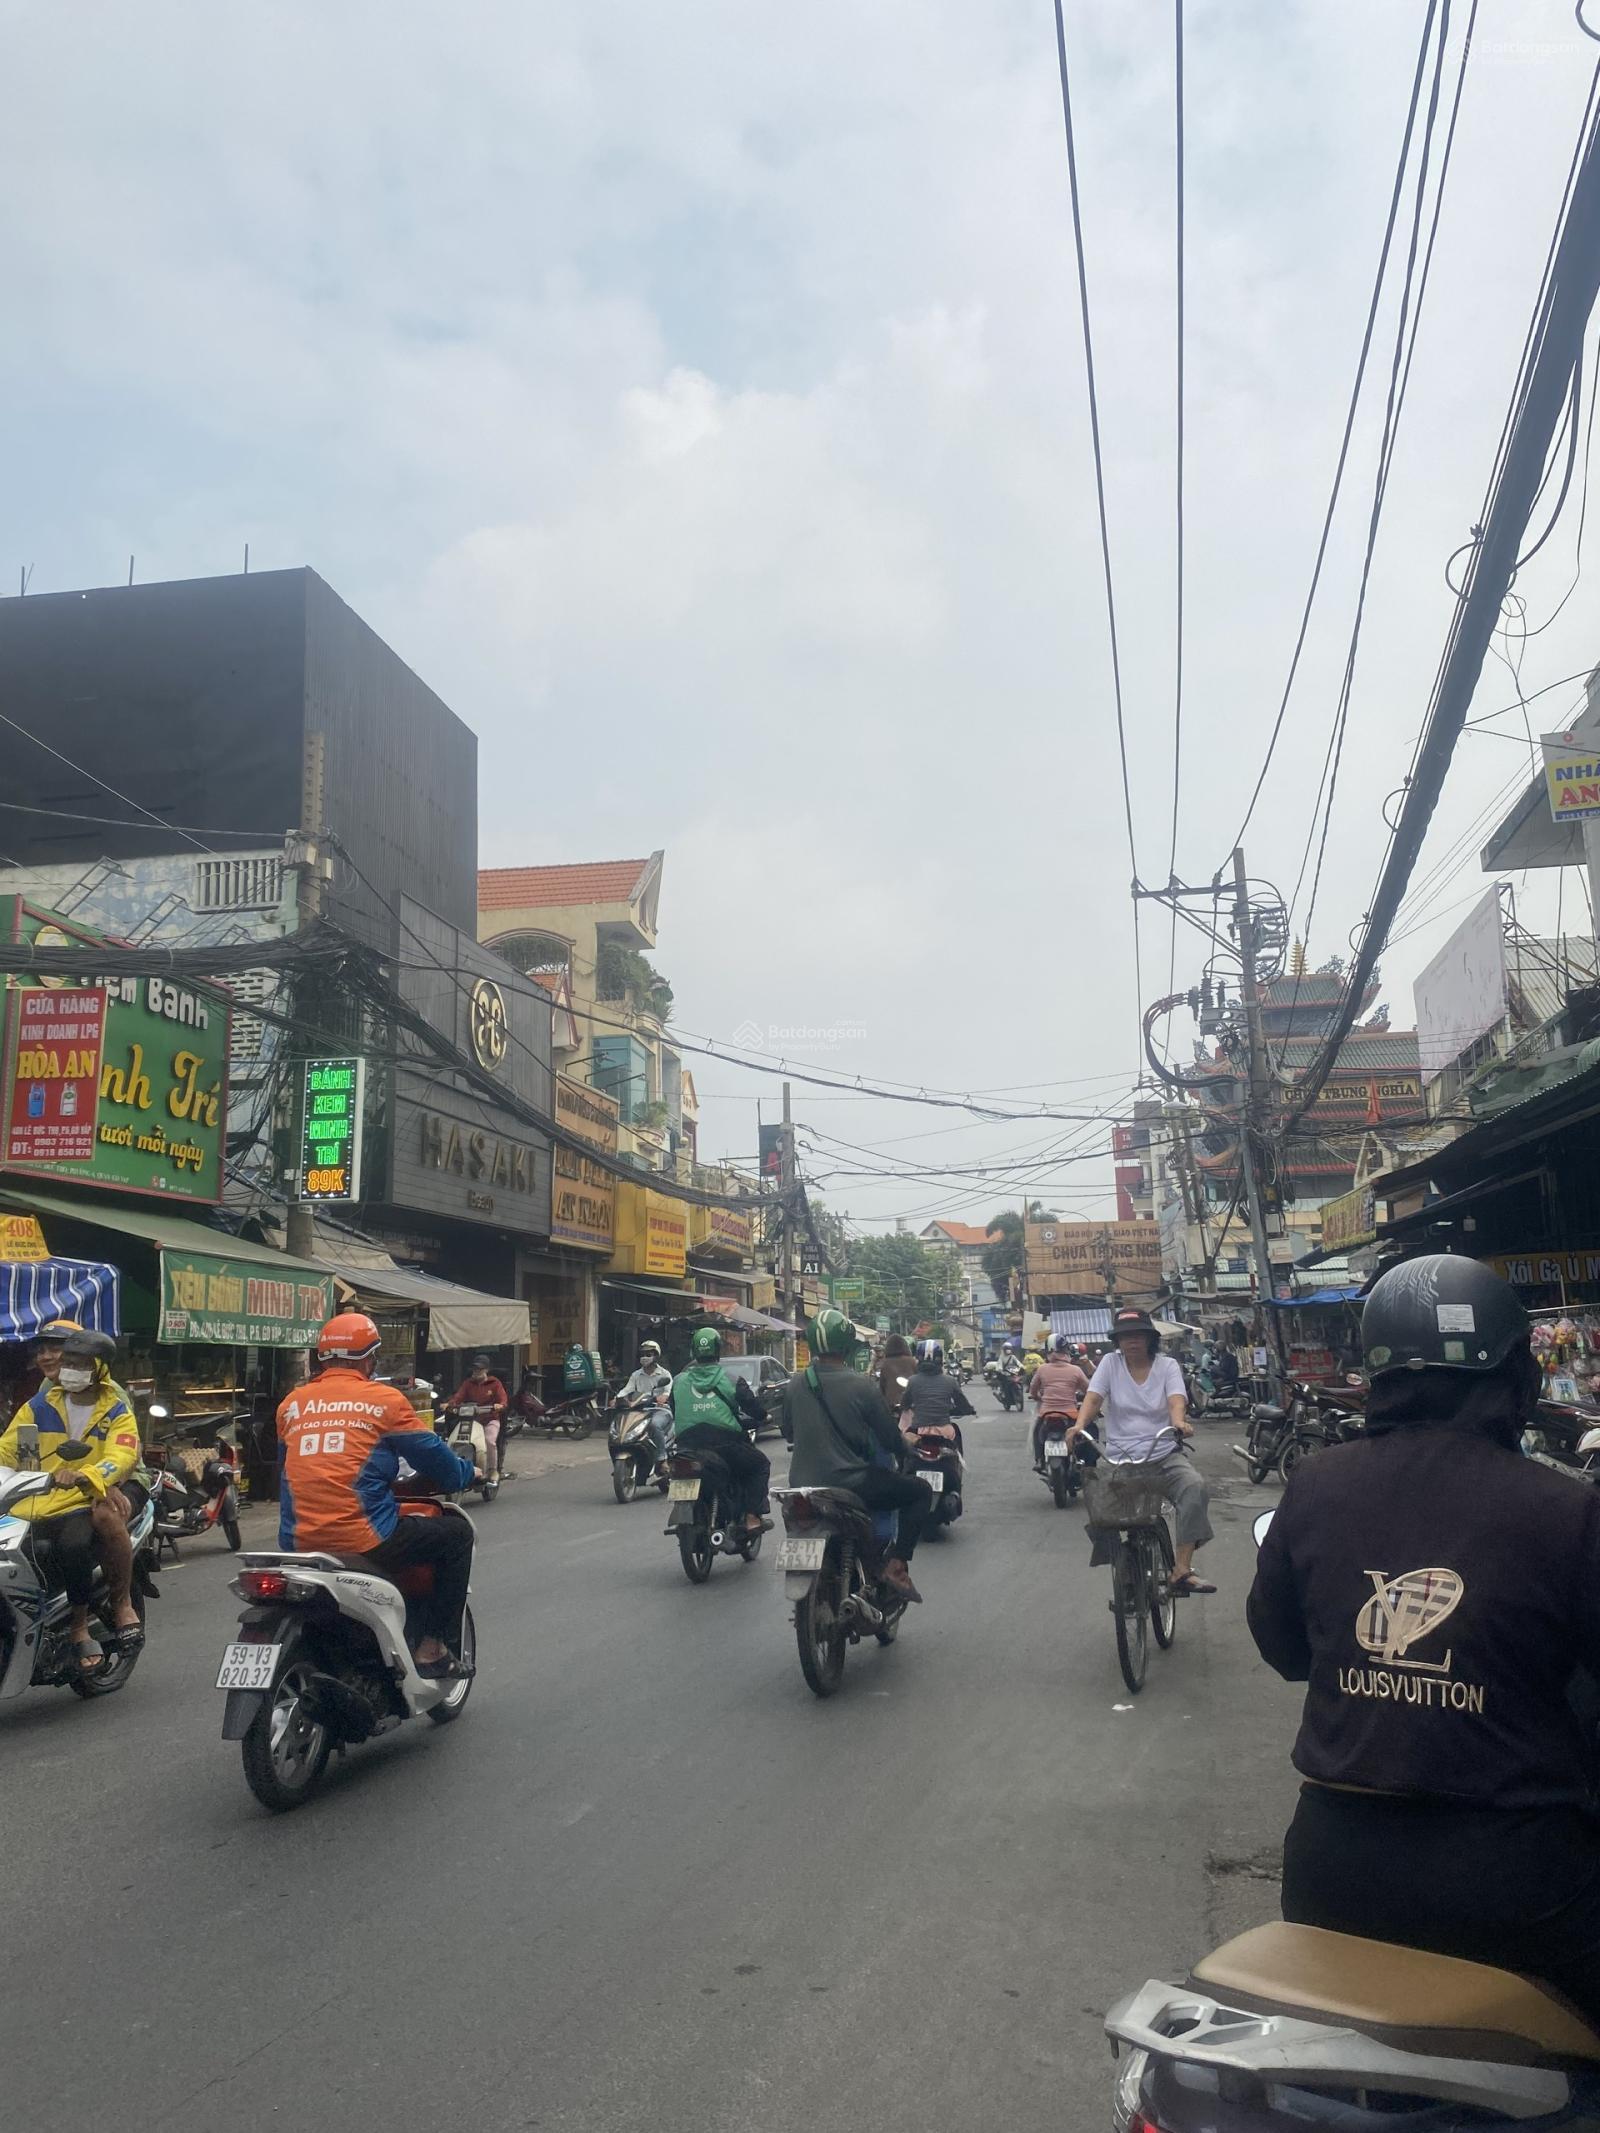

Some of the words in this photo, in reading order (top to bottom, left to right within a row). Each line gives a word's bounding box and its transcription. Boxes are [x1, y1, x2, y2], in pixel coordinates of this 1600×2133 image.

[26, 991, 56, 1015] CỬA
[59, 995, 99, 1015] HÀNG
[21, 1024, 45, 1040] KINH
[47, 1024, 78, 1040] DOANH
[80, 1023, 99, 1039] LPG
[17, 1043, 61, 1079] HÒA
[63, 1050, 97, 1079] AN
[169, 1050, 221, 1127] Trí
[310, 1066, 351, 1090] BÁNH
[1323, 1086, 1369, 1100] TRUNG
[313, 1094, 347, 1115] KEM
[309, 1119, 349, 1140] MINH
[12, 1142, 32, 1155] ĐT:
[100, 1123, 133, 1146] tươi
[137, 1124, 167, 1154] mỗi
[169, 1138, 204, 1172] ngày
[315, 1141, 340, 1165] TRÍ
[420, 1112, 536, 1195] HASAKI
[307, 1168, 345, 1192] 89K
[6, 1218, 33, 1238] 408
[804, 1262, 819, 1273] A1
[1504, 1259, 1533, 1284] Xôi
[246, 1277, 294, 1319] MINH
[297, 1276, 329, 1322] TRÍ
[303, 1399, 384, 1417] Ahamove
[692, 1402, 716, 1412] gojek
[303, 1421, 320, 1429] CAO
[322, 1419, 346, 1427] GIAO
[347, 1419, 374, 1431] HÀNG
[336, 1576, 372, 1587] VISION
[230, 1646, 272, 1665] 59-V3
[220, 1667, 271, 1687] 820.37
[1339, 1667, 1484, 1714] LOUISVUITTON
